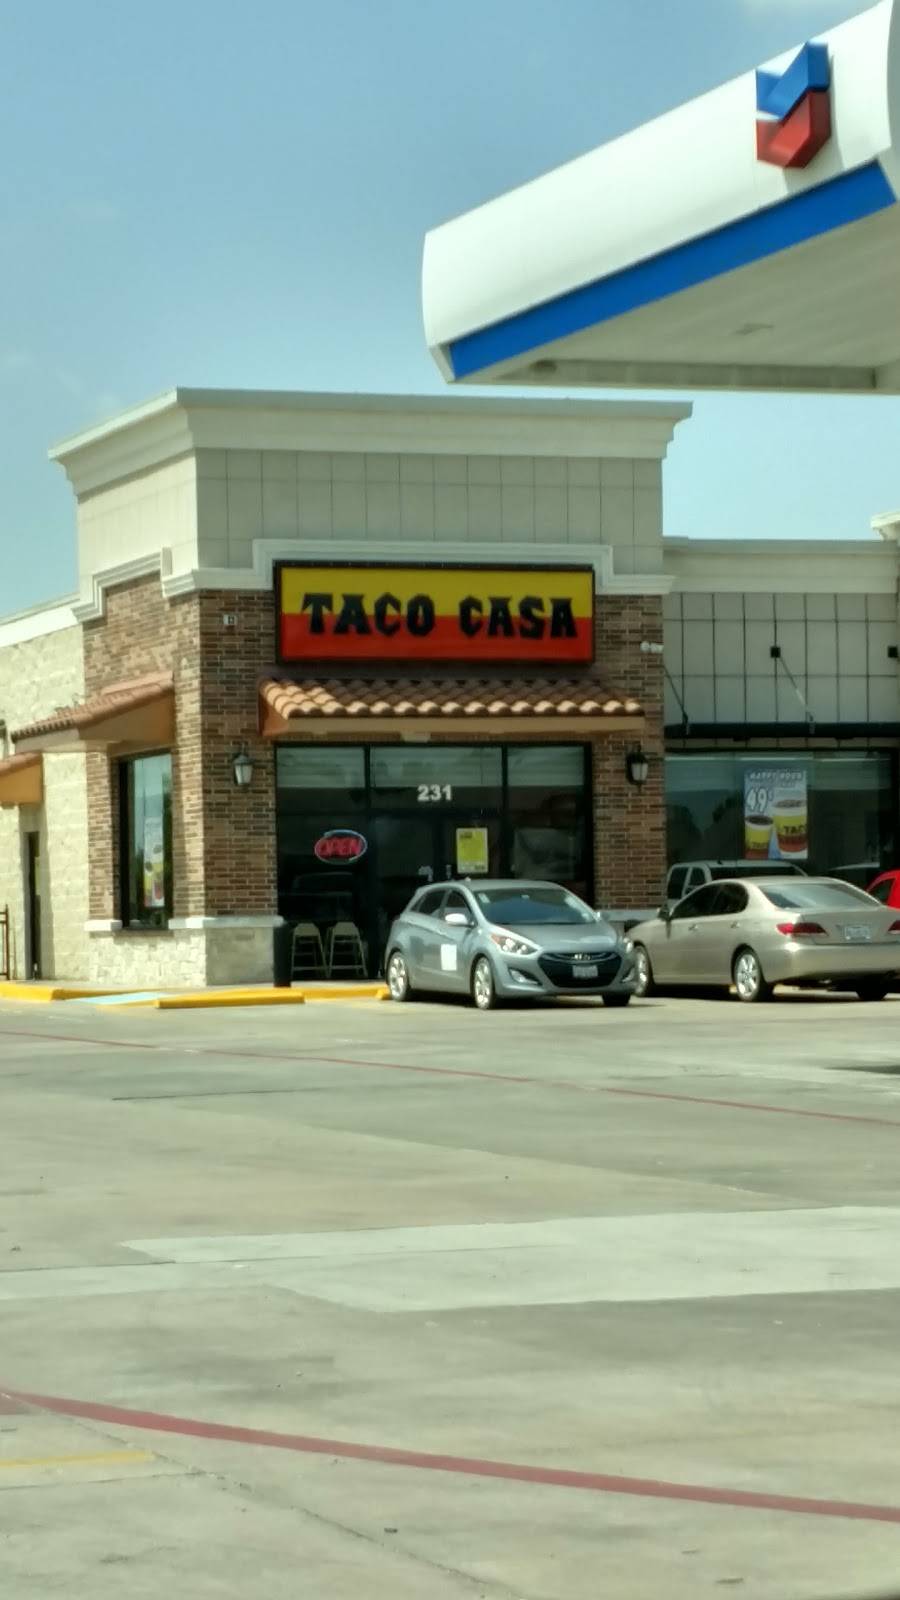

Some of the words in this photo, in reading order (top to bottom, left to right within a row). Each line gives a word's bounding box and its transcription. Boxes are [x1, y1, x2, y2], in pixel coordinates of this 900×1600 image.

[301, 592, 435, 637] TACO
[459, 595, 578, 639] CASA
[417, 784, 453, 802] 231
[318, 837, 361, 857] OPEN
